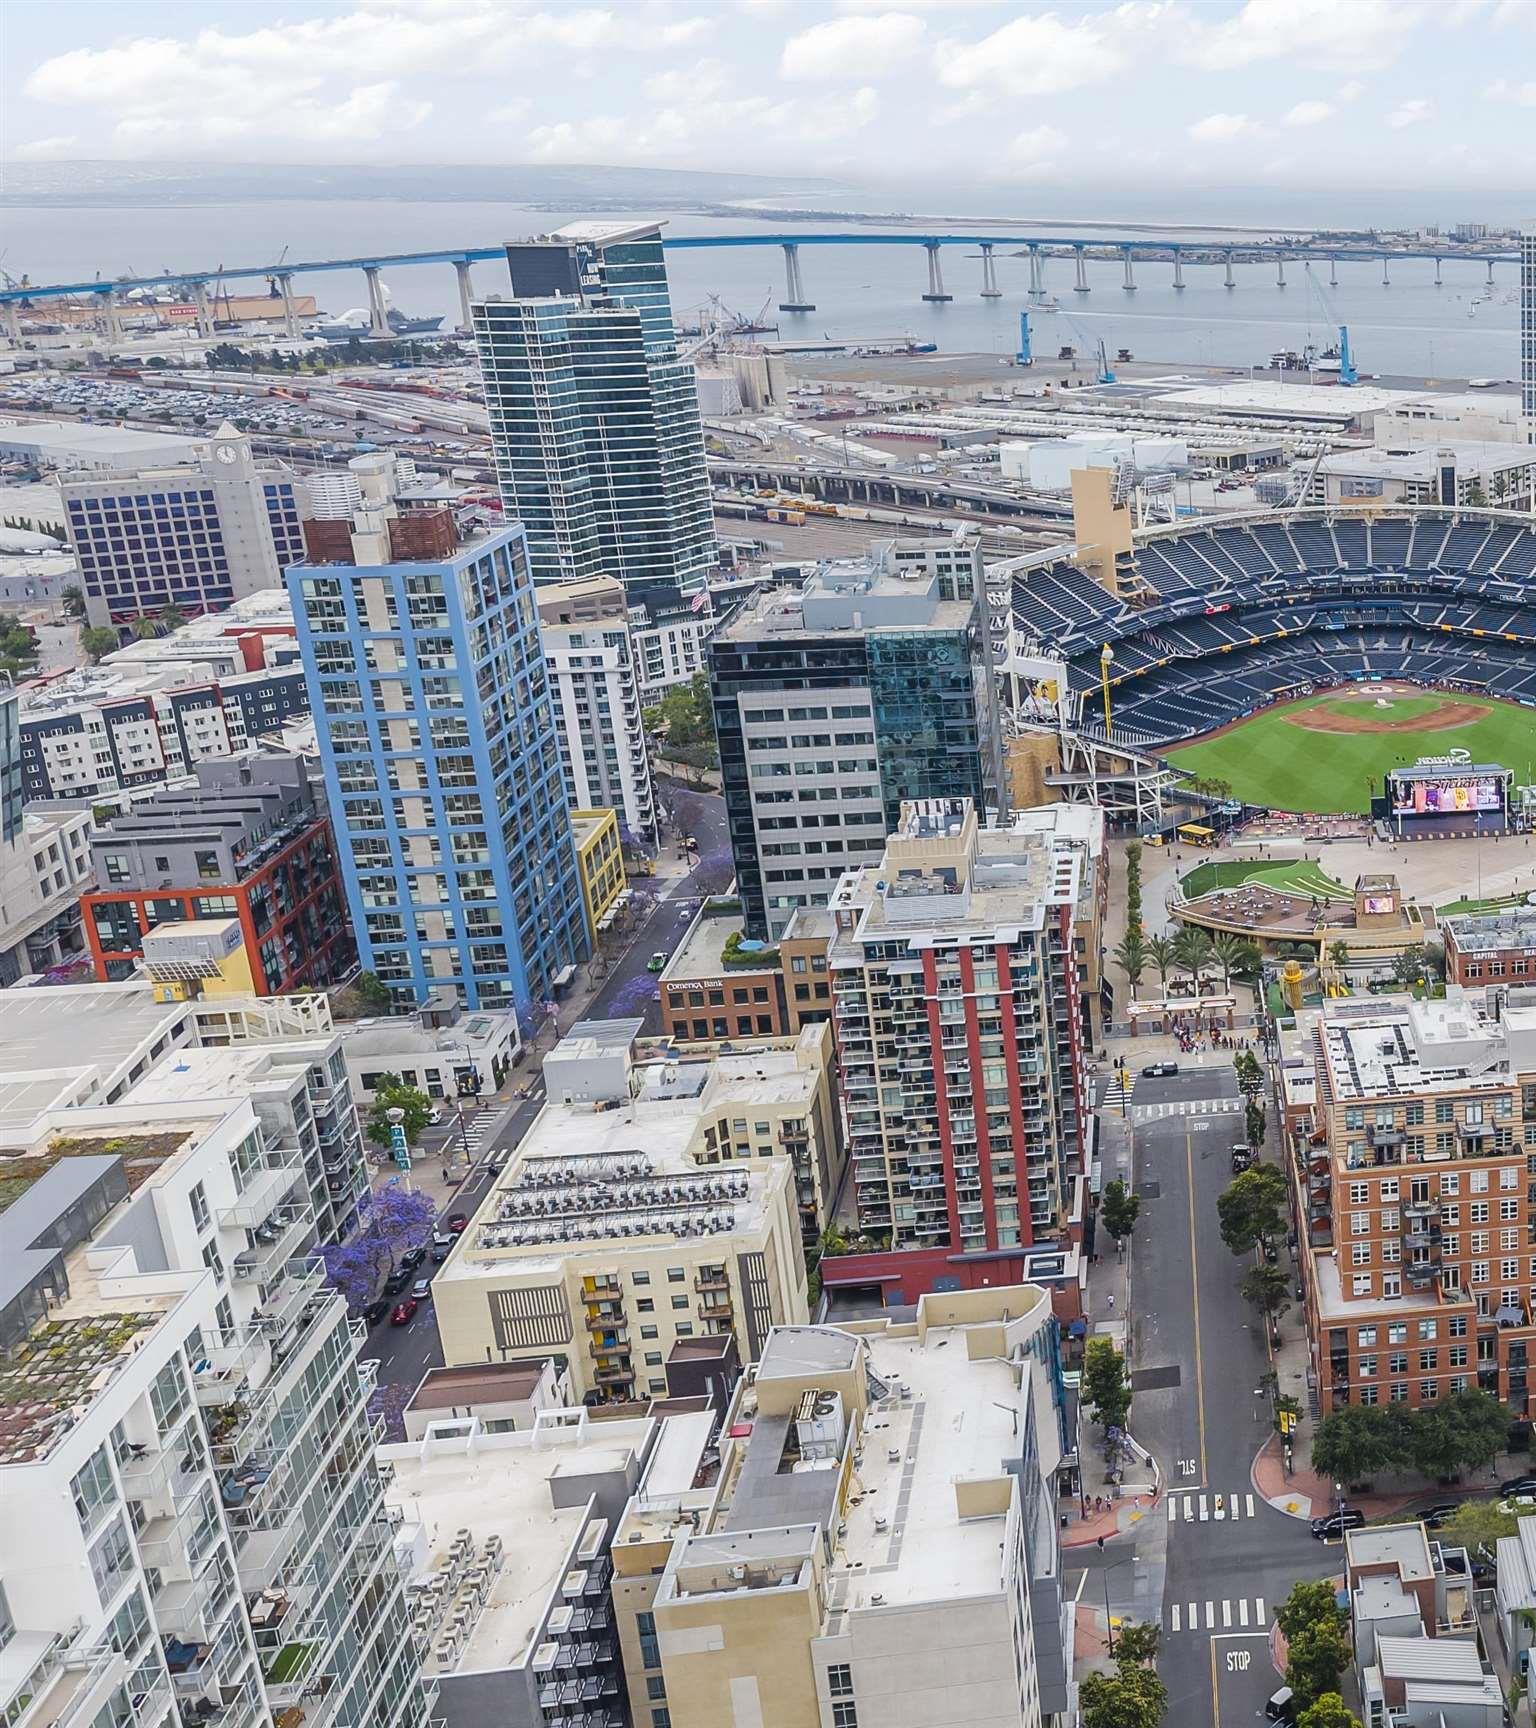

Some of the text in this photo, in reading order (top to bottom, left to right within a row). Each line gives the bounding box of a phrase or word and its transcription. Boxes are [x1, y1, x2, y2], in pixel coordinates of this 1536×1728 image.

[1473, 951, 1498, 960] CAPITAL
[393, 1128, 408, 1169] PARK
[1227, 1651, 1250, 1671] STOP
